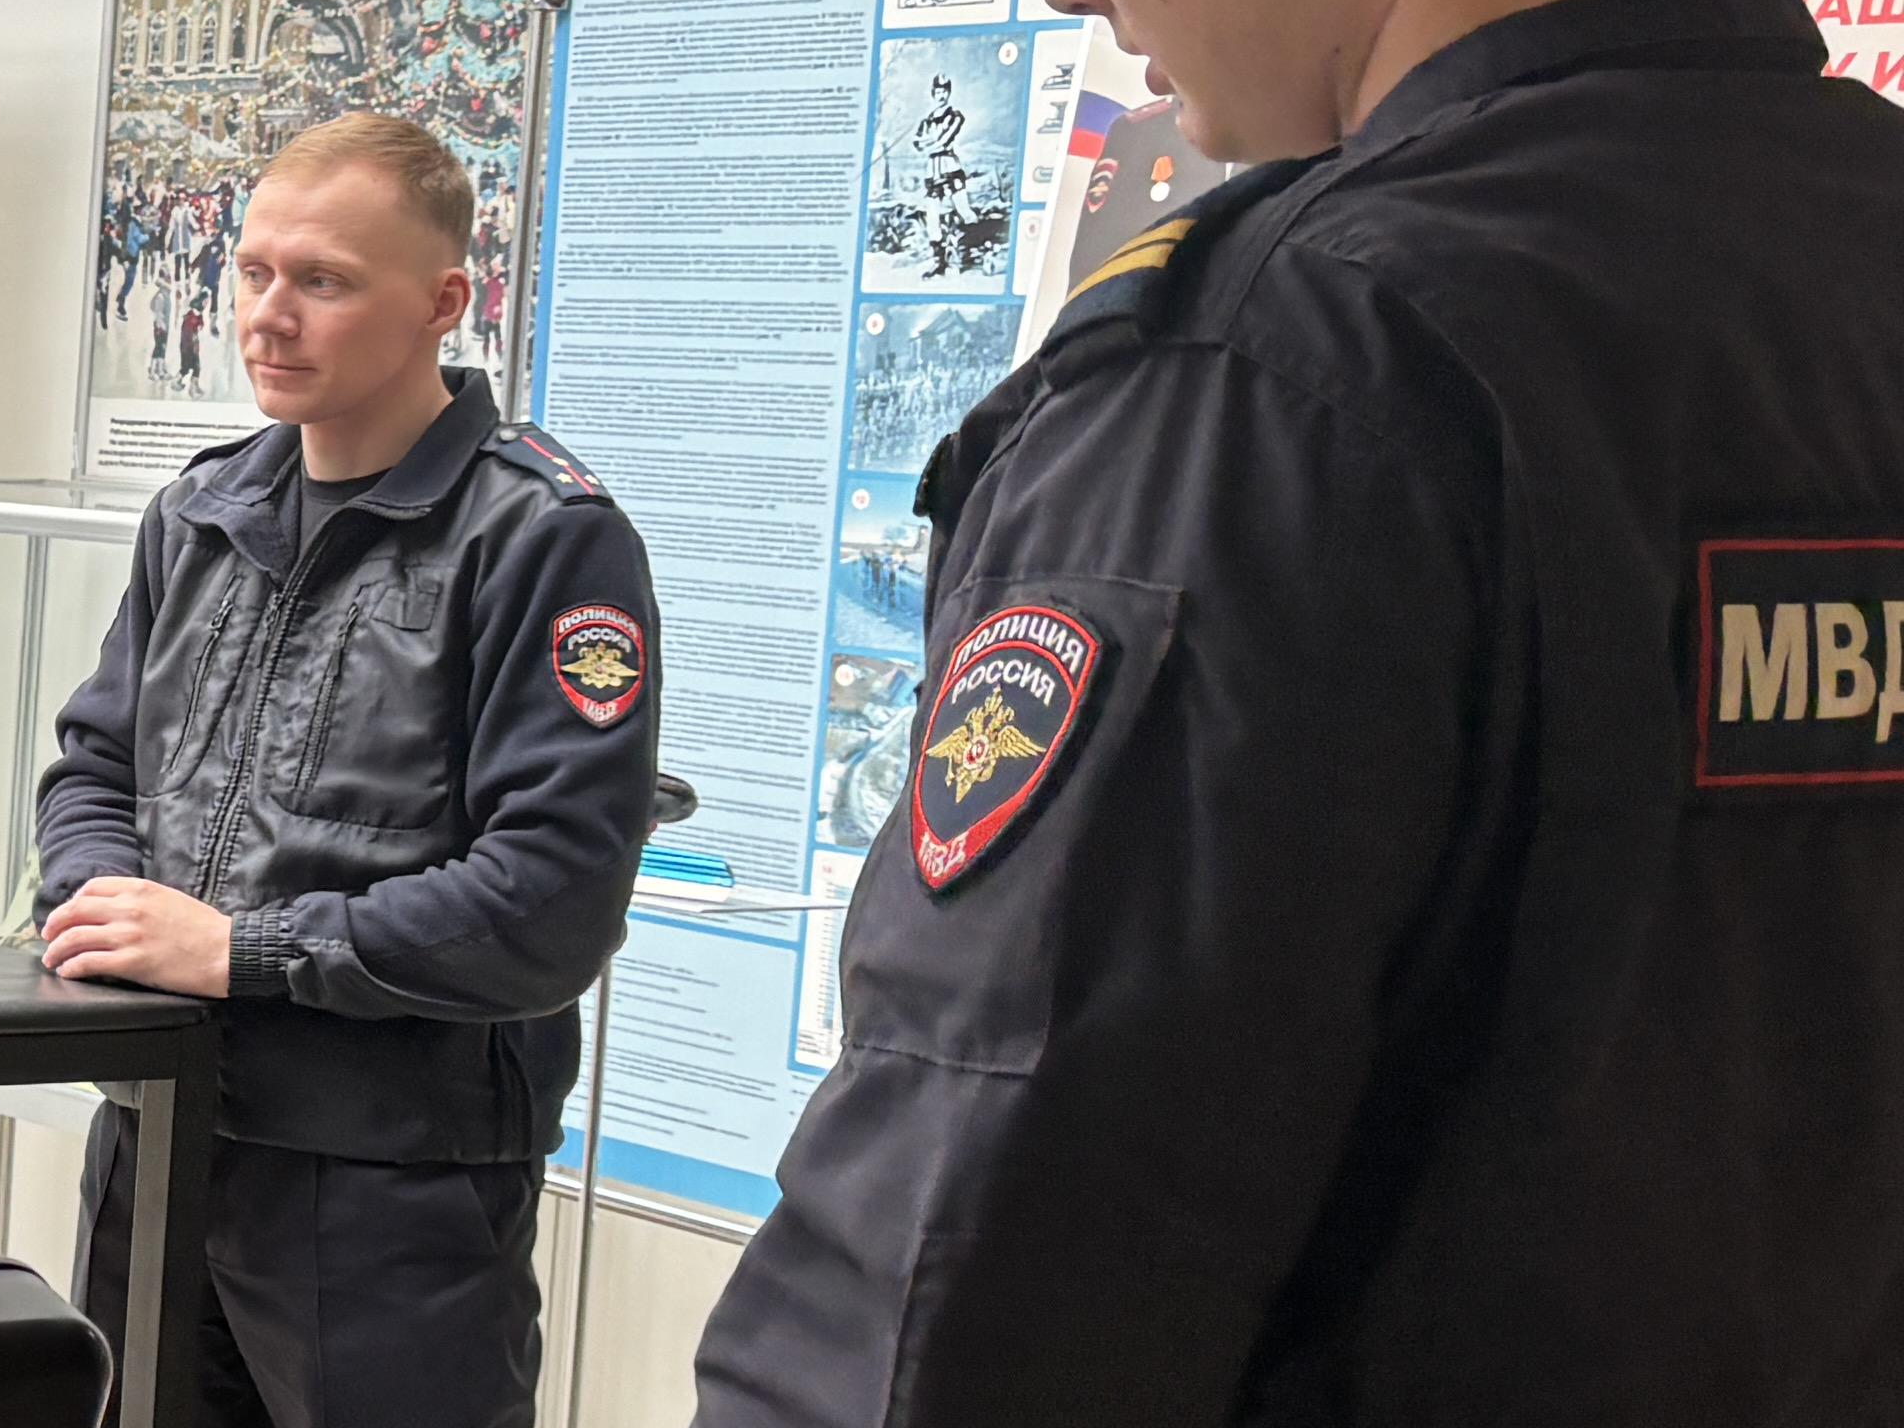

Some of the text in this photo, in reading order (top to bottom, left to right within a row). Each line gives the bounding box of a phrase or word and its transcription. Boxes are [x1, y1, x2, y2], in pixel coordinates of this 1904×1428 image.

[558, 608, 639, 638] ПОЛИЦИЯ
[567, 627, 631, 653] РОССИЯ
[952, 614, 1085, 675] ПОЛИЦИЯ
[951, 658, 1057, 708] РОССИЯ
[919, 830, 969, 877] МВД
